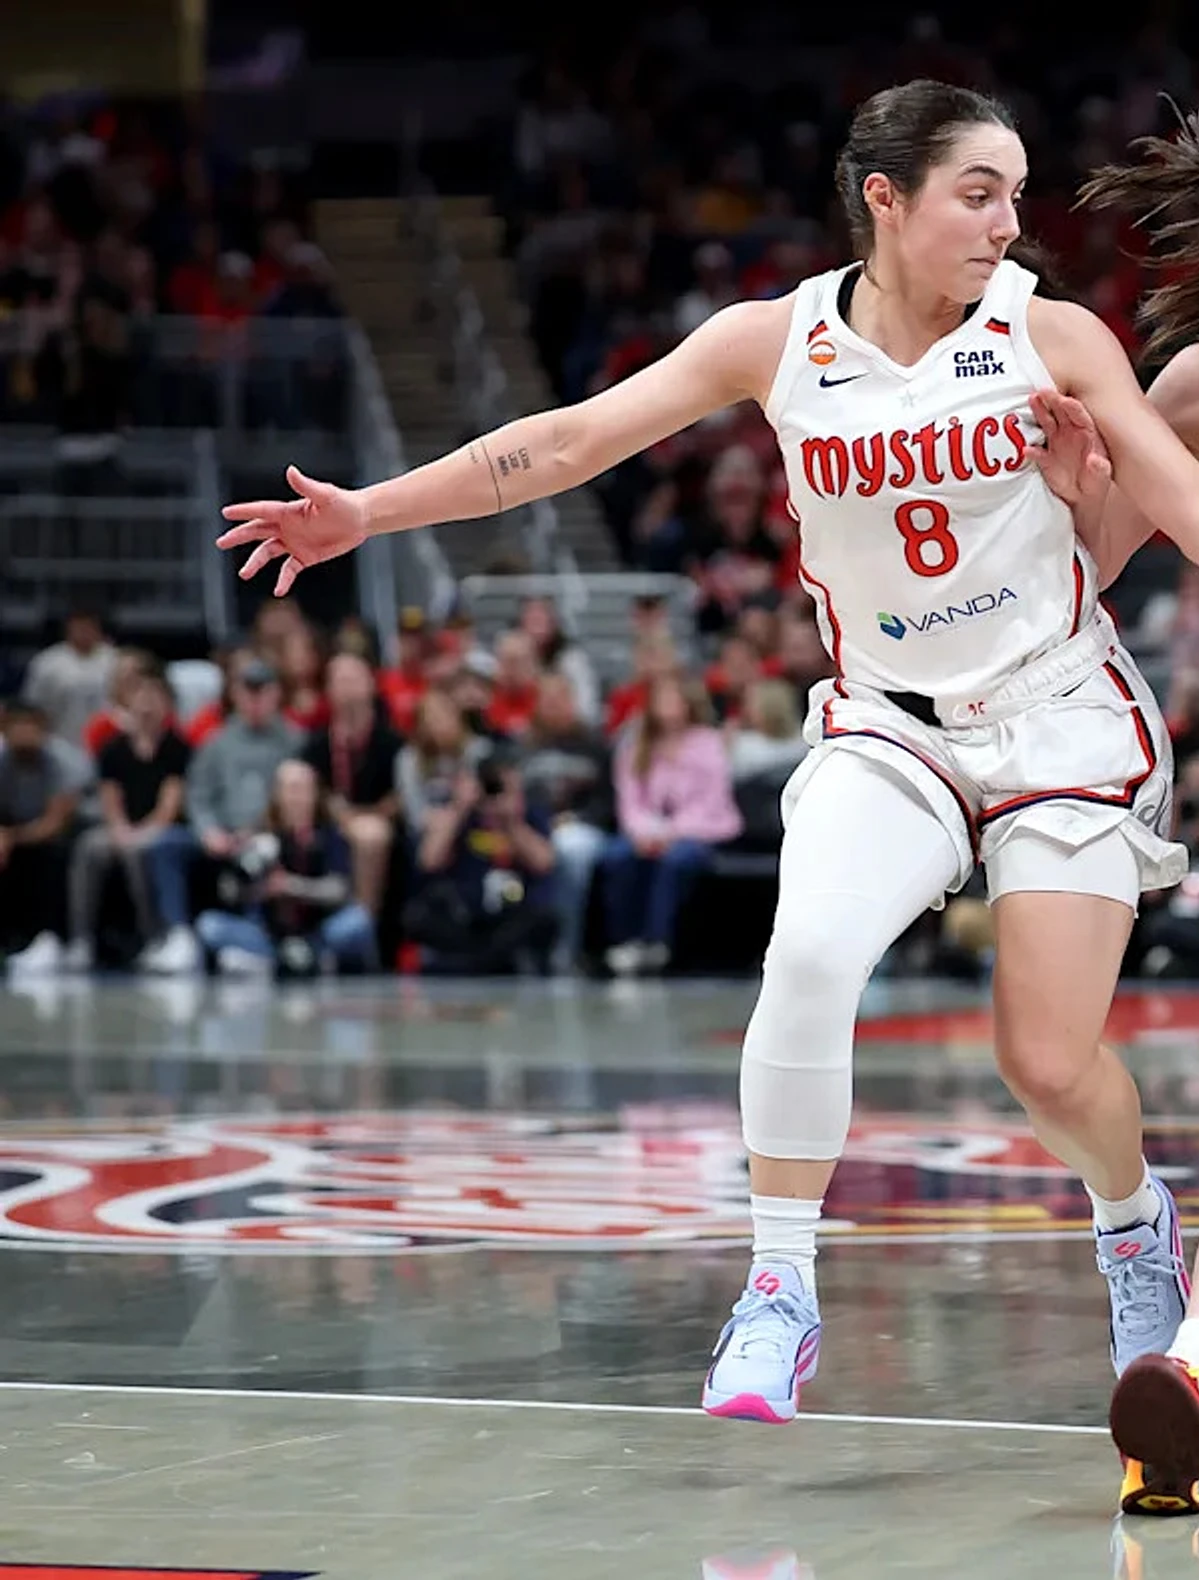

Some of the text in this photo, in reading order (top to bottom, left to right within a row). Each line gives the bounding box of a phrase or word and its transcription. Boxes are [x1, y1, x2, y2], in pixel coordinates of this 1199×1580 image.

[953, 350, 994, 364] CAR
[955, 361, 1005, 378] max
[894, 500, 959, 577] 8
[906, 587, 1018, 631] VANDA
